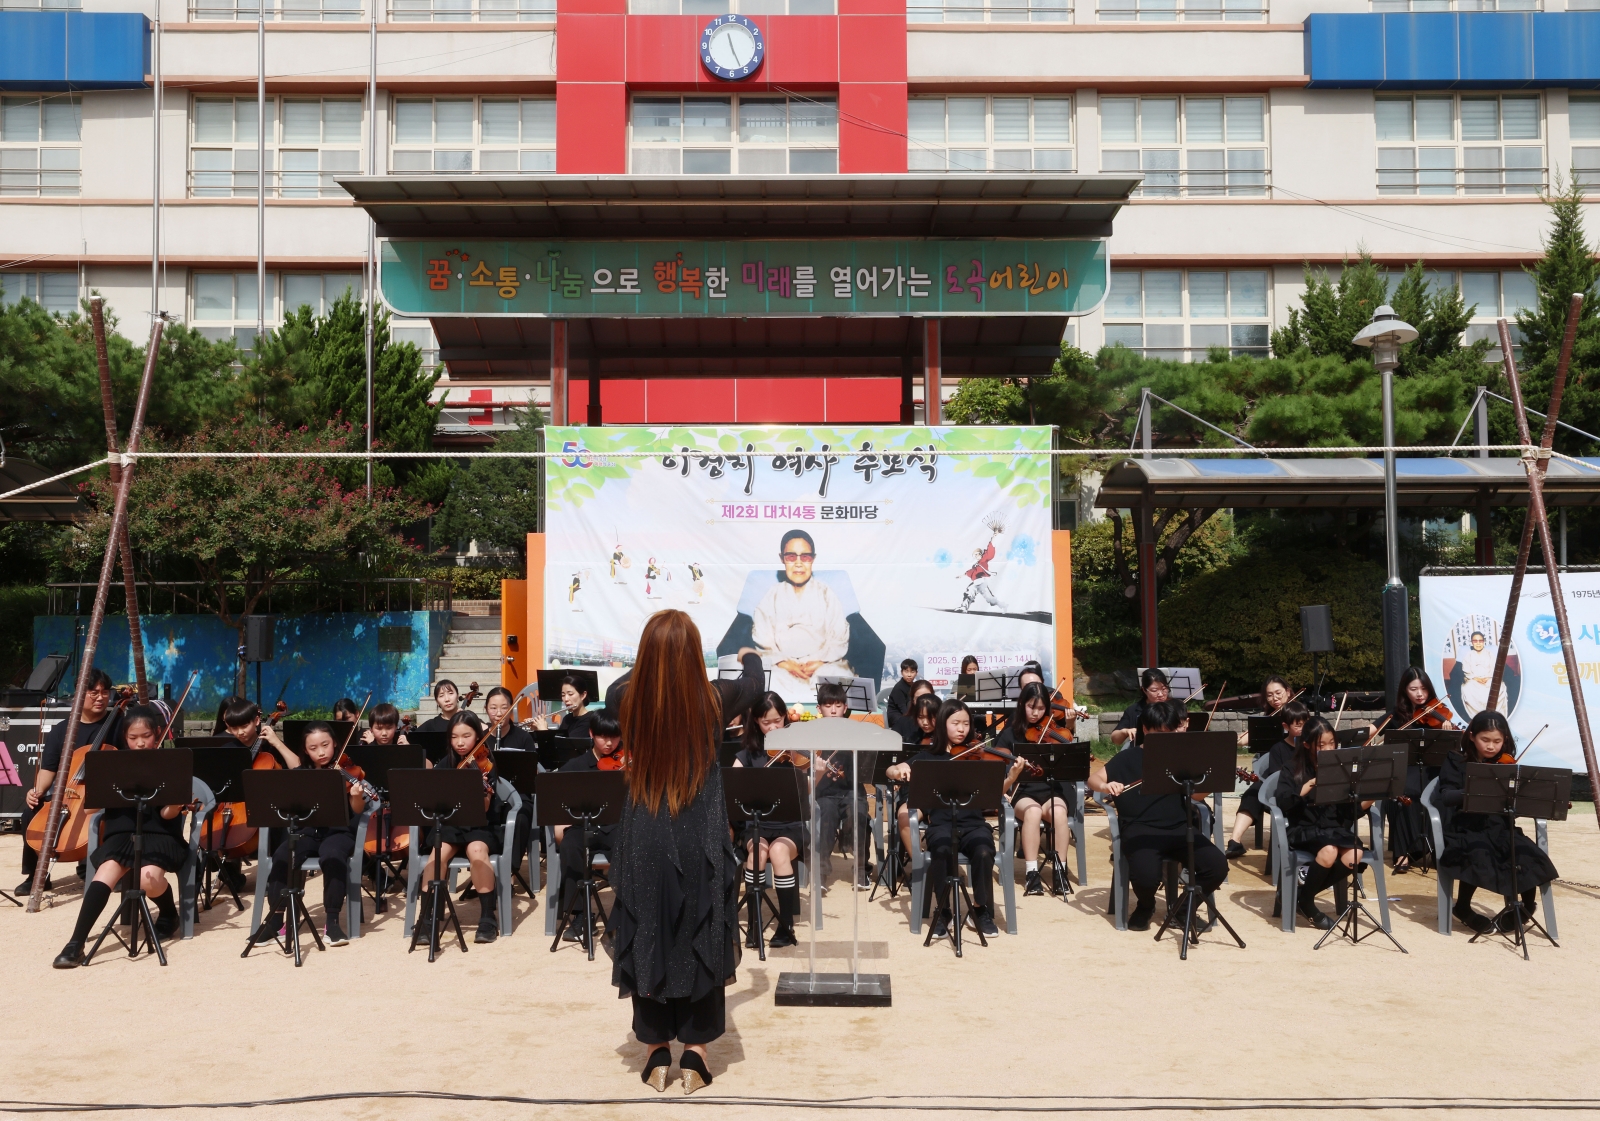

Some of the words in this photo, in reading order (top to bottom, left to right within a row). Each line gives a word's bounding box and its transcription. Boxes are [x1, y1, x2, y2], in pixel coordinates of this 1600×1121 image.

[653, 261, 730, 299] 행복한
[741, 260, 817, 299] 미래를
[829, 265, 932, 298] 열어가는
[946, 259, 1069, 303] 도곡어린이
[771, 444, 839, 497] 여사
[853, 441, 938, 483] 추모식
[721, 504, 759, 519] 제2회
[763, 504, 816, 520] 대치4동
[820, 505, 879, 520] 문화마당
[928, 656, 949, 664] 2025.
[951, 656, 959, 664] 9.
[989, 655, 1006, 664] 11시
